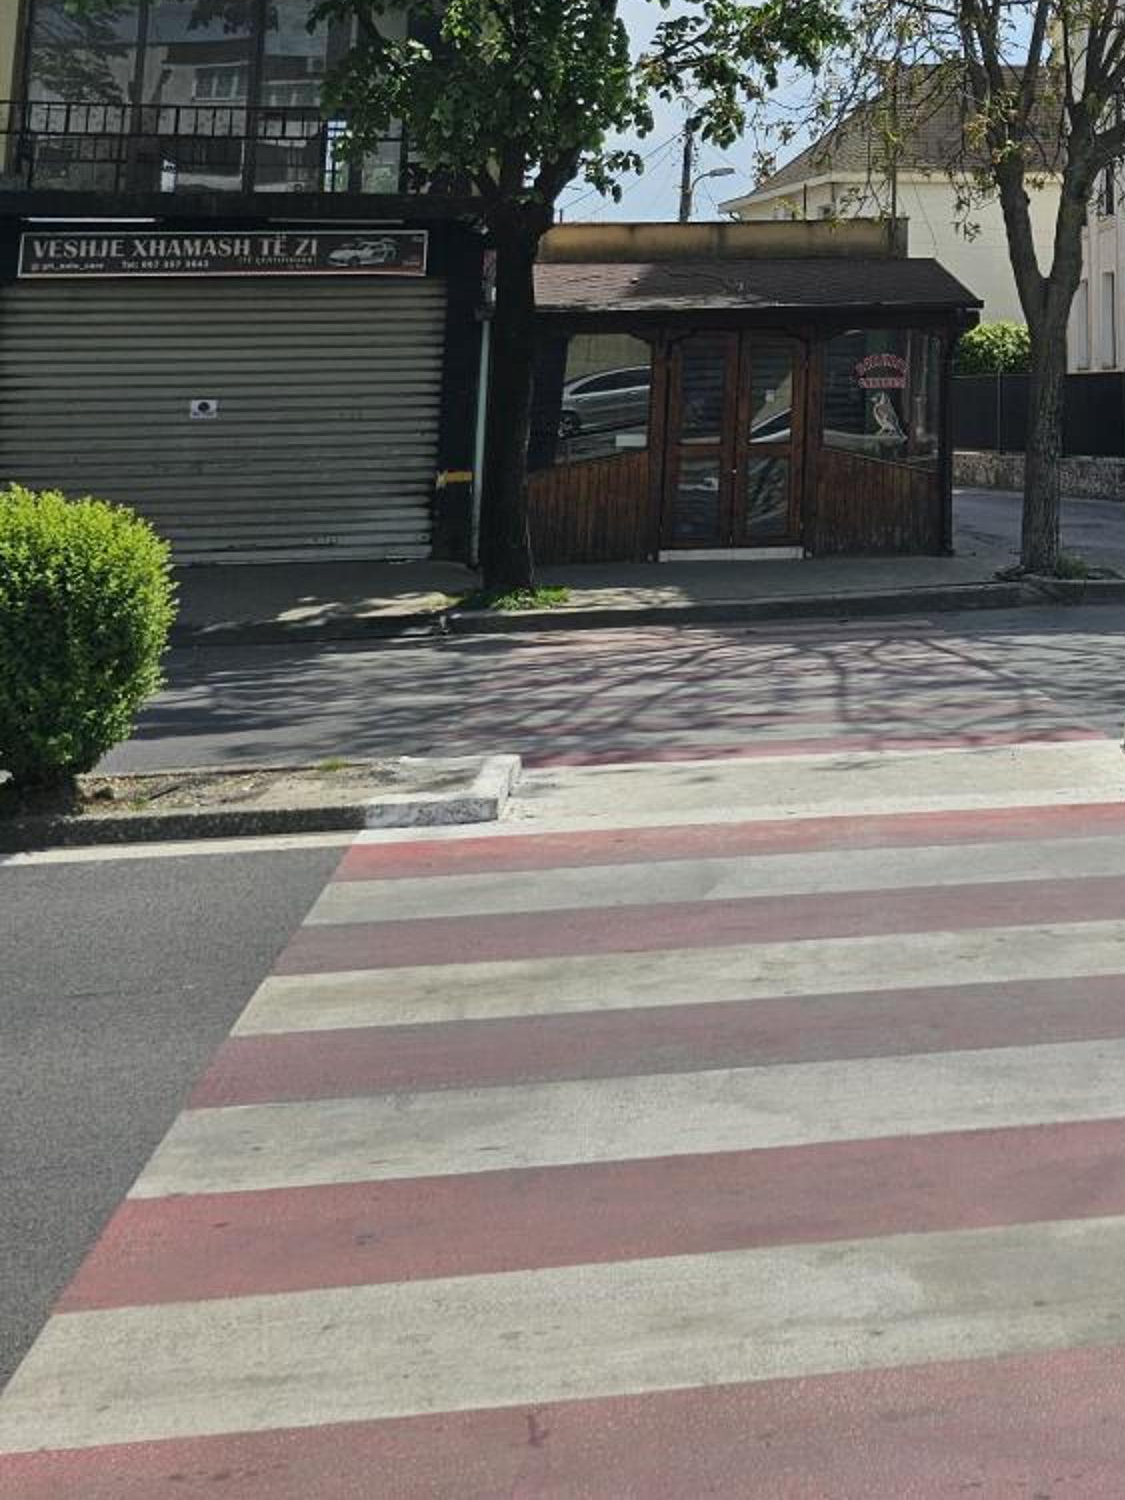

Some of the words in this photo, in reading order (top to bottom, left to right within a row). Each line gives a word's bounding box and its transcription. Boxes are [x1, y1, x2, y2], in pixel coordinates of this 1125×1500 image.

[33, 239, 125, 258] VESHJE
[132, 238, 250, 258] XHAMASH
[260, 234, 287, 256] TË
[295, 238, 318, 256] ZI
